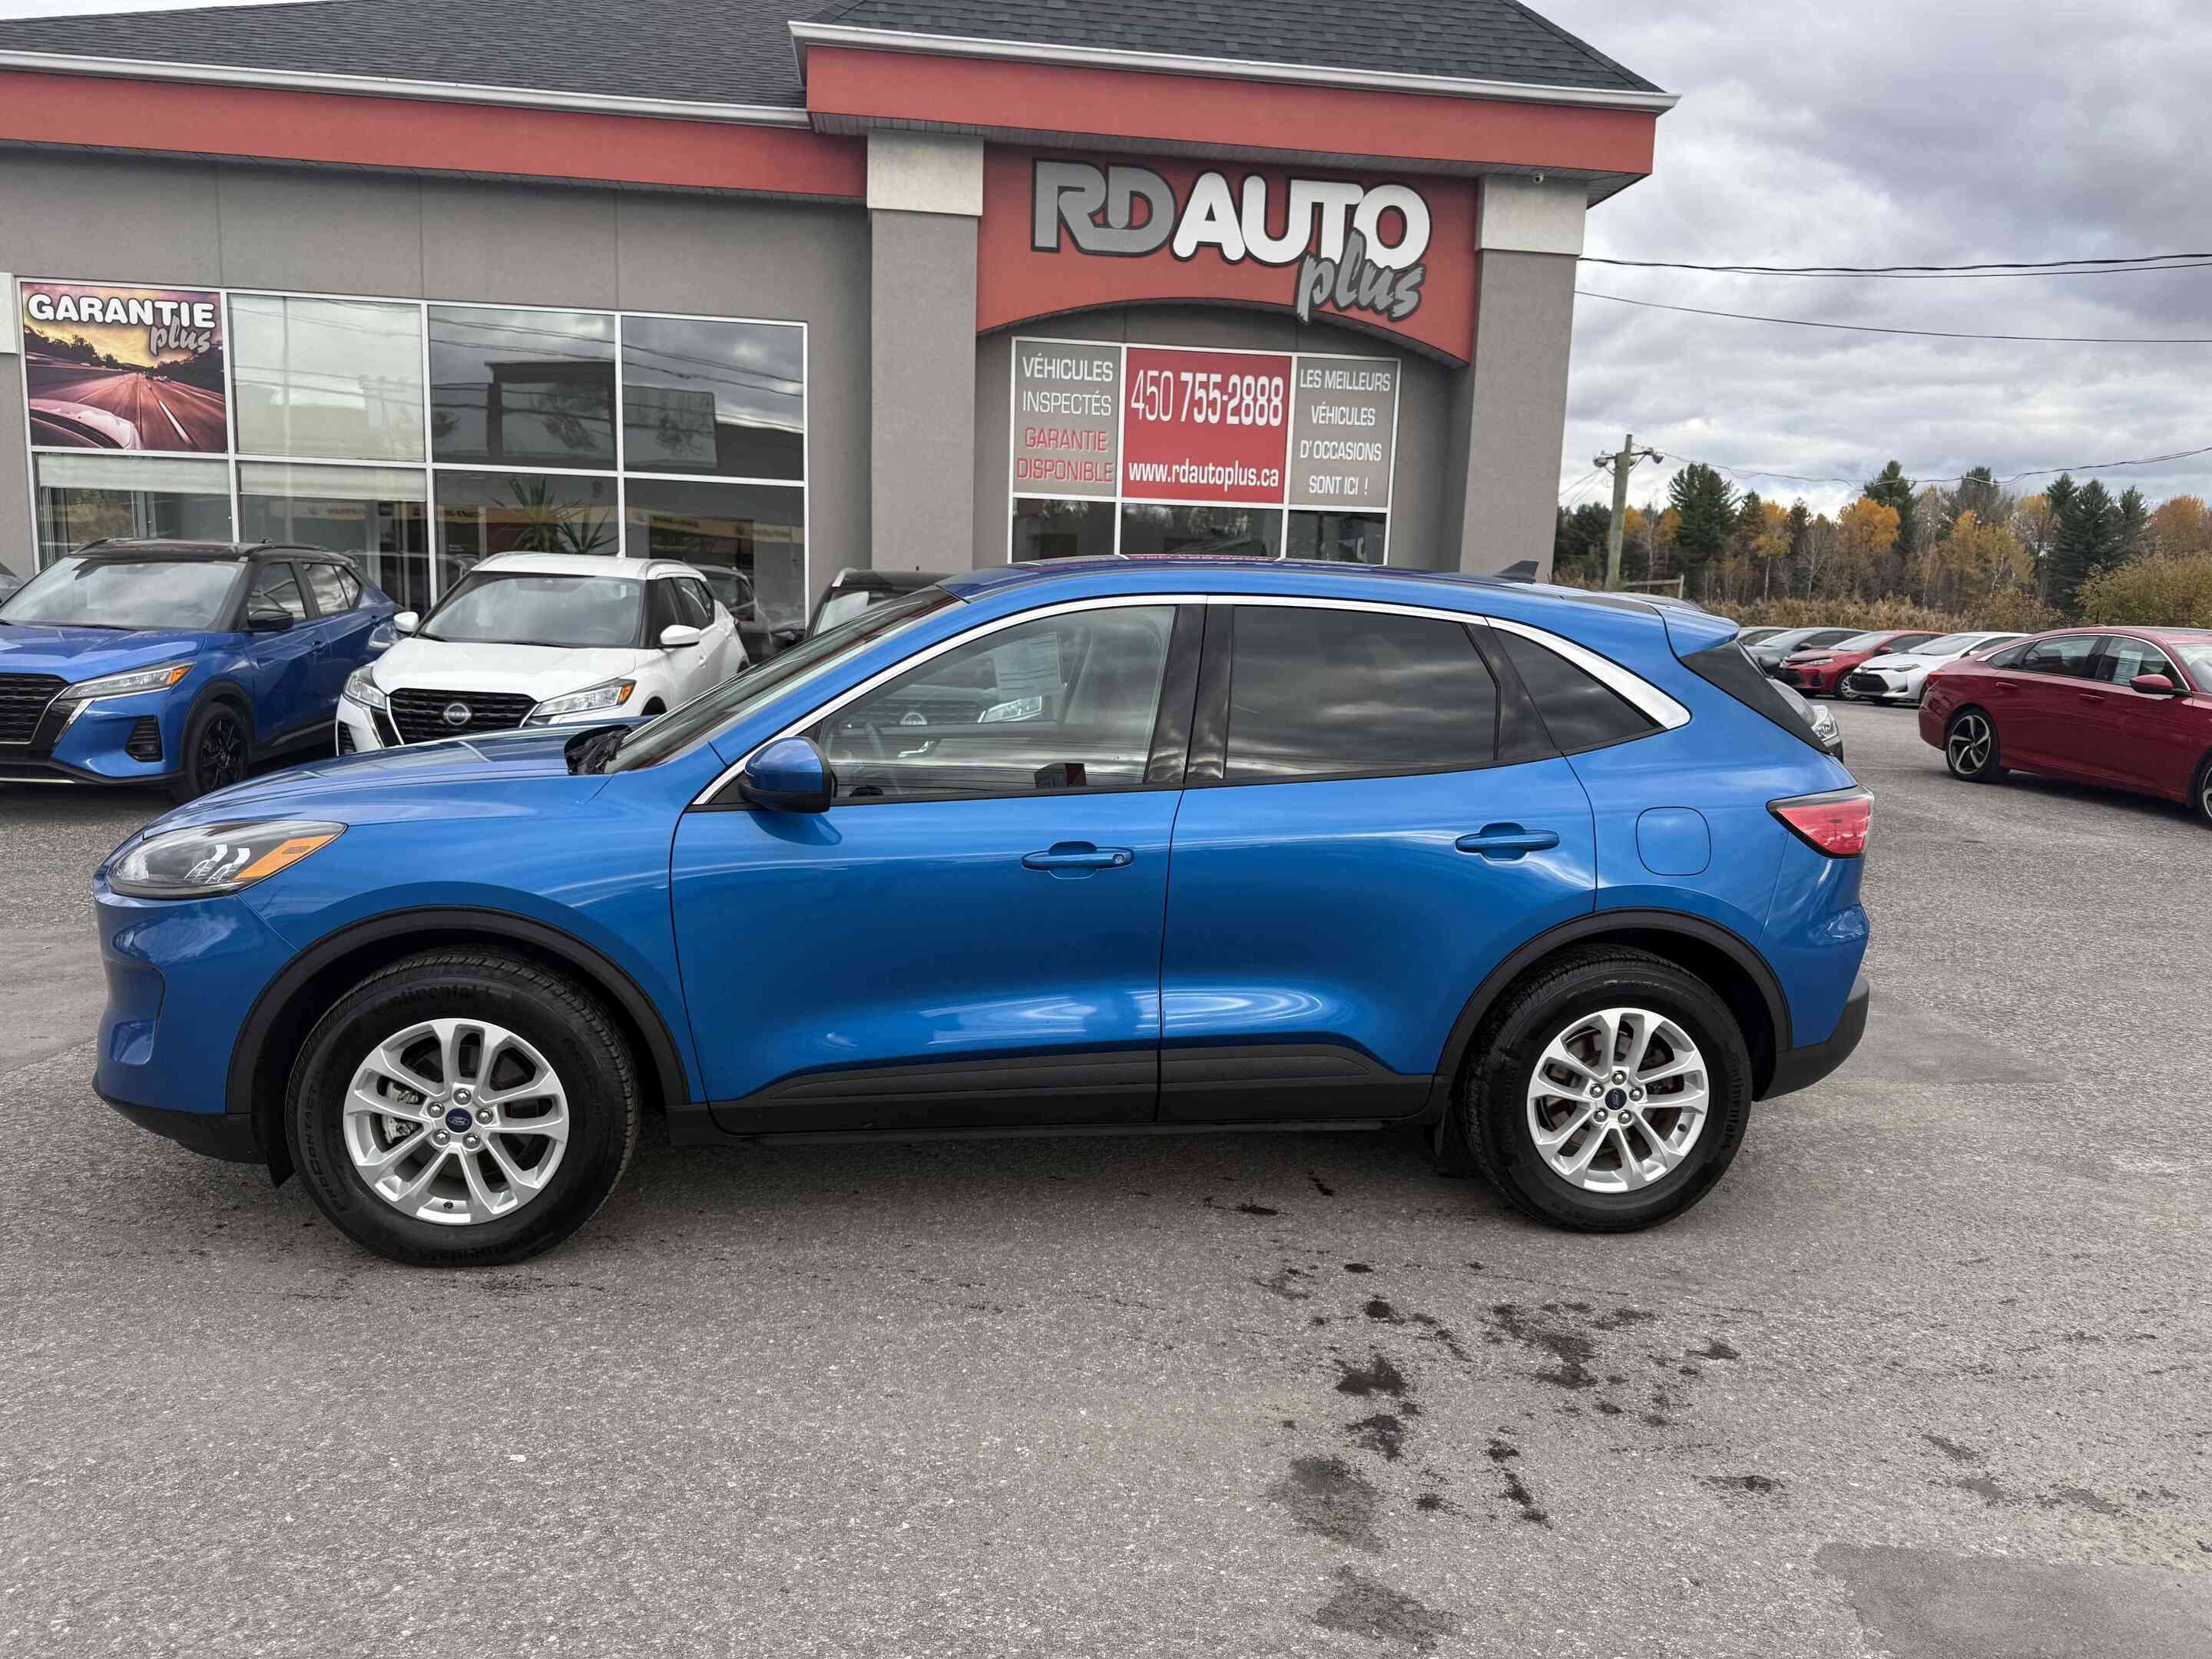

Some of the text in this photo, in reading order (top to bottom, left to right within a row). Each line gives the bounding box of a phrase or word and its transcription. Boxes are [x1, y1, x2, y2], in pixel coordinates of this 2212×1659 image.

[1294, 227, 1426, 323] plus
[28, 293, 216, 329] GARANTIE
[148, 316, 212, 356] plus
[1022, 353, 1113, 382] VÉHICULES
[1300, 369, 1391, 392] LES MEILLEURS
[1022, 390, 1111, 416] INSPECTÉS
[1131, 369, 1284, 426] 450 755-2888
[1311, 401, 1376, 426] VÉHICULES
[1025, 426, 1108, 453] GARANTIE
[1016, 457, 1114, 483] DISPONIBLE
[1128, 458, 1279, 492] www.rdautoplus.ca
[1309, 475, 1343, 495] SONT
[1344, 477, 1359, 495] ICI
